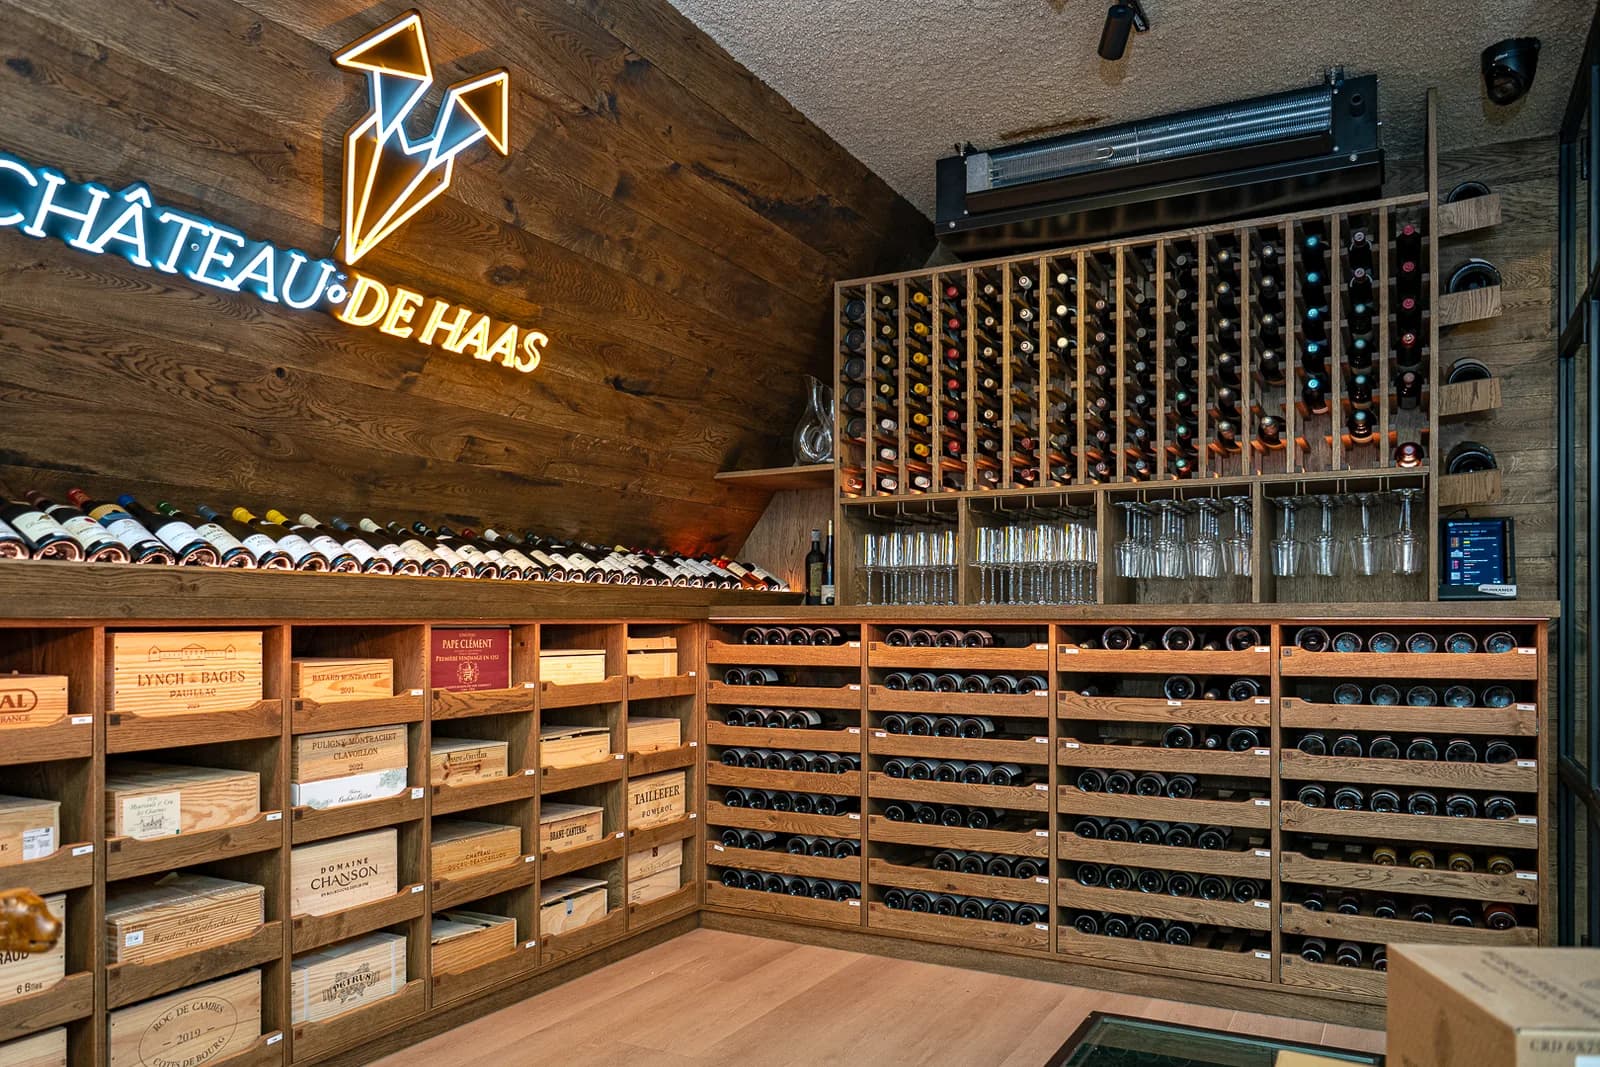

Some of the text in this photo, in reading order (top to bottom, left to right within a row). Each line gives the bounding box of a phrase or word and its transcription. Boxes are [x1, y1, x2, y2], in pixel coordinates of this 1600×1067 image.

[340, 275, 424, 339] DE
[418, 299, 549, 373] HAAS
[443, 639, 459, 649] PAPE
[137, 670, 246, 687] LYNCH BAGES
[169, 687, 217, 698] PAUILLAC
[634, 784, 681, 805] TAILLEFER
[641, 803, 673, 818] POMEROL
[320, 857, 369, 874] DOMAINE
[310, 863, 379, 890] CHANSON
[16, 984, 23, 994] 6
[333, 972, 372, 993] PETRUS
[152, 1001, 224, 1032] ROC DE CAMBES
[176, 1028, 201, 1045] 2019
[196, 1037, 225, 1062] BOURG
